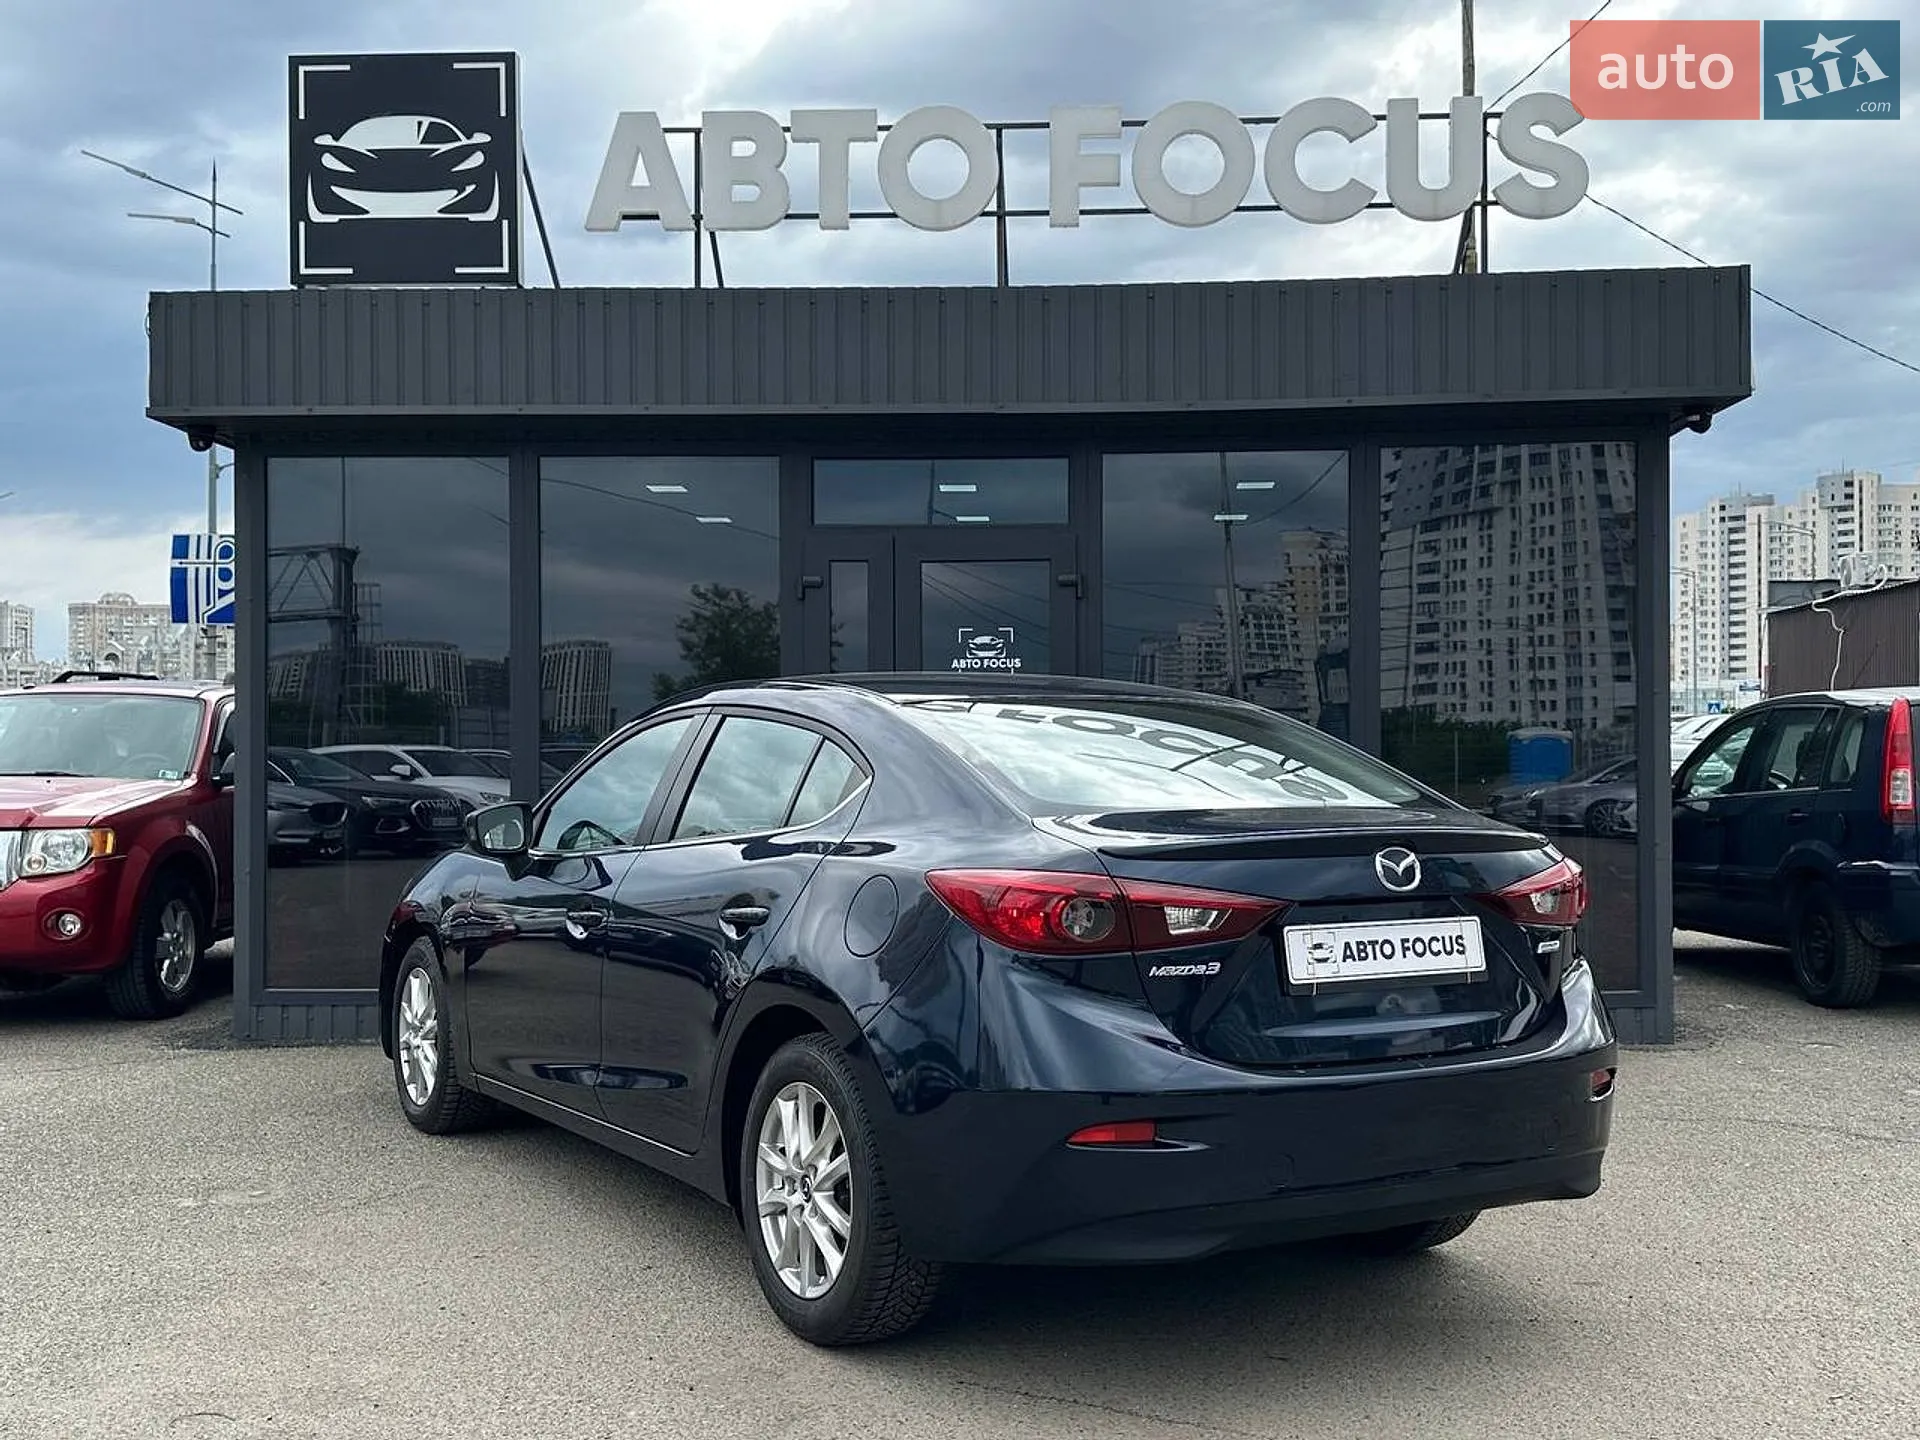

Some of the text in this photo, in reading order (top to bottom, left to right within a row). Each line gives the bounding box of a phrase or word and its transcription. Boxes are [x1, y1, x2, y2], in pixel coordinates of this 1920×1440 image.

[1048, 92, 1590, 228] FOCUS
[983, 658, 1022, 669] FOCUS
[1400, 934, 1467, 959] FOCUS
